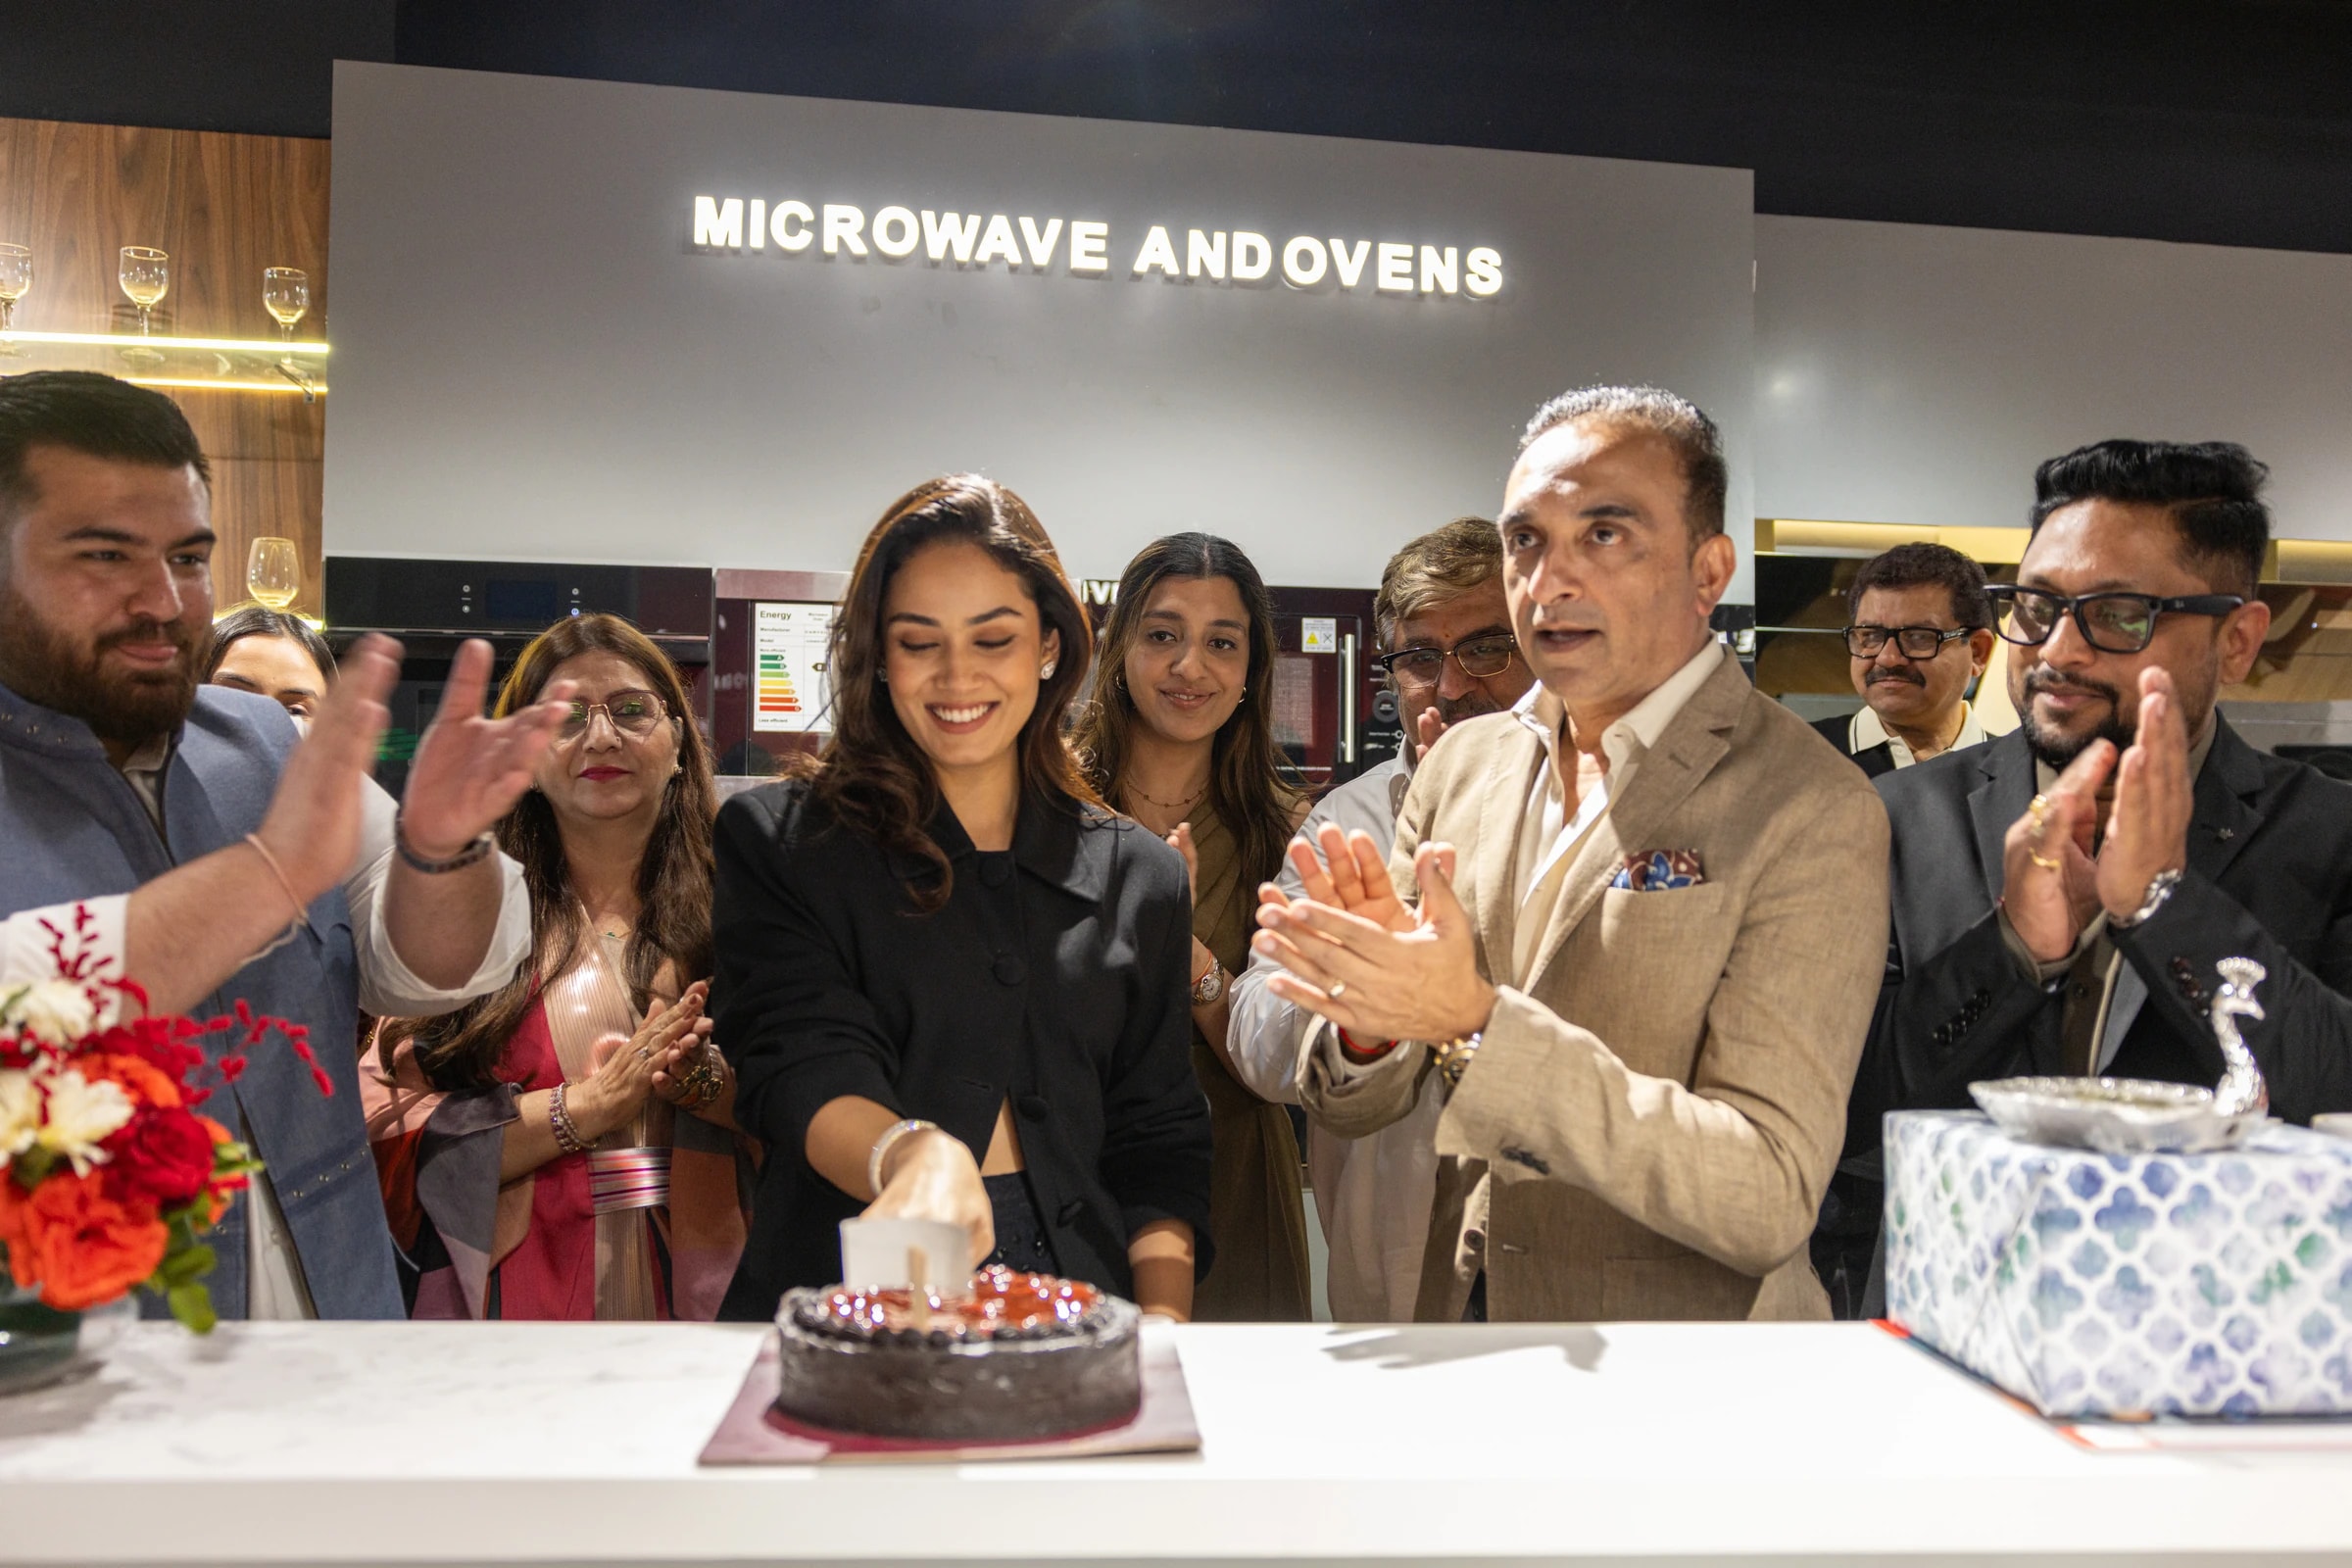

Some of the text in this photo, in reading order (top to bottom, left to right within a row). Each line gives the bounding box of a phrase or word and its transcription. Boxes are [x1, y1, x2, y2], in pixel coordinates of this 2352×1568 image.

[693, 195, 1503, 295] MICROWAVE AND OVENS
[760, 611, 792, 620] Energy
